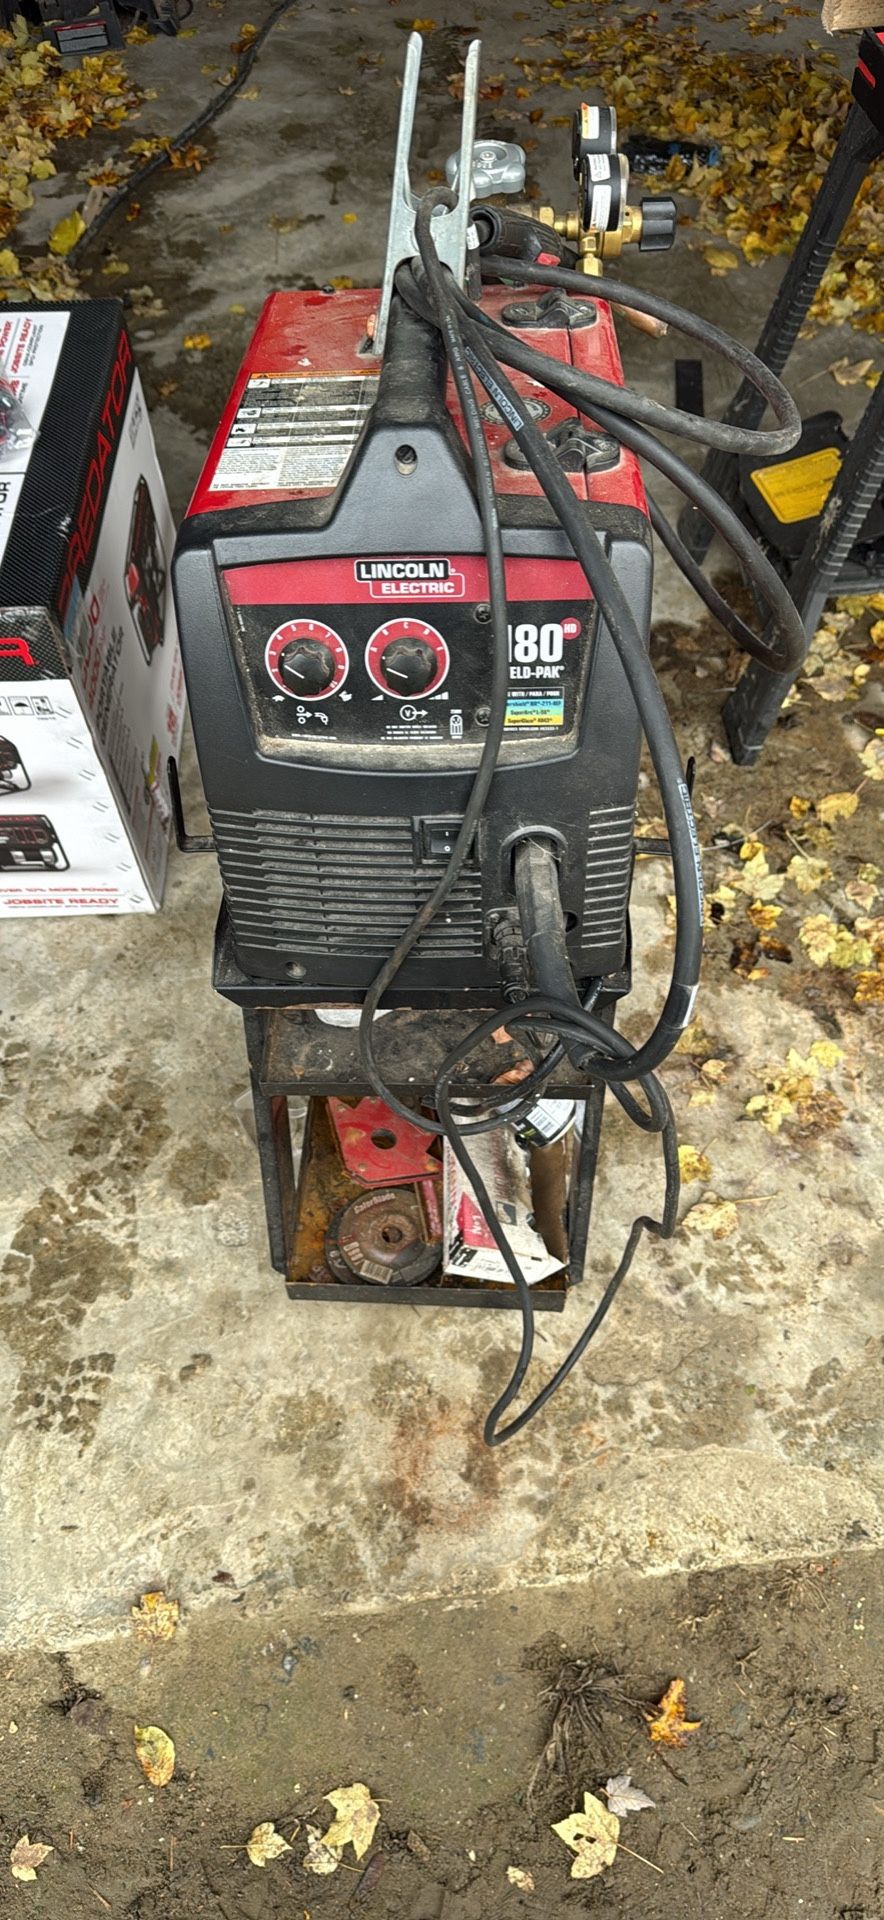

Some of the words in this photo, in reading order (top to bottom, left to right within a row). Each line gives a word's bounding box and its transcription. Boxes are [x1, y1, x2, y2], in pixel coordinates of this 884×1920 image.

[461, 374, 473, 396] CABLE
[490, 386, 524, 430] LINCOLN
[56, 329, 131, 614] PREDATOR
[360, 563, 444, 578] LINCOLN
[382, 582, 455, 594] ELECTRIC
[403, 621, 409, 629] C
[564, 623, 577, 633] HD
[509, 665, 565, 679] ELD-PAK®
